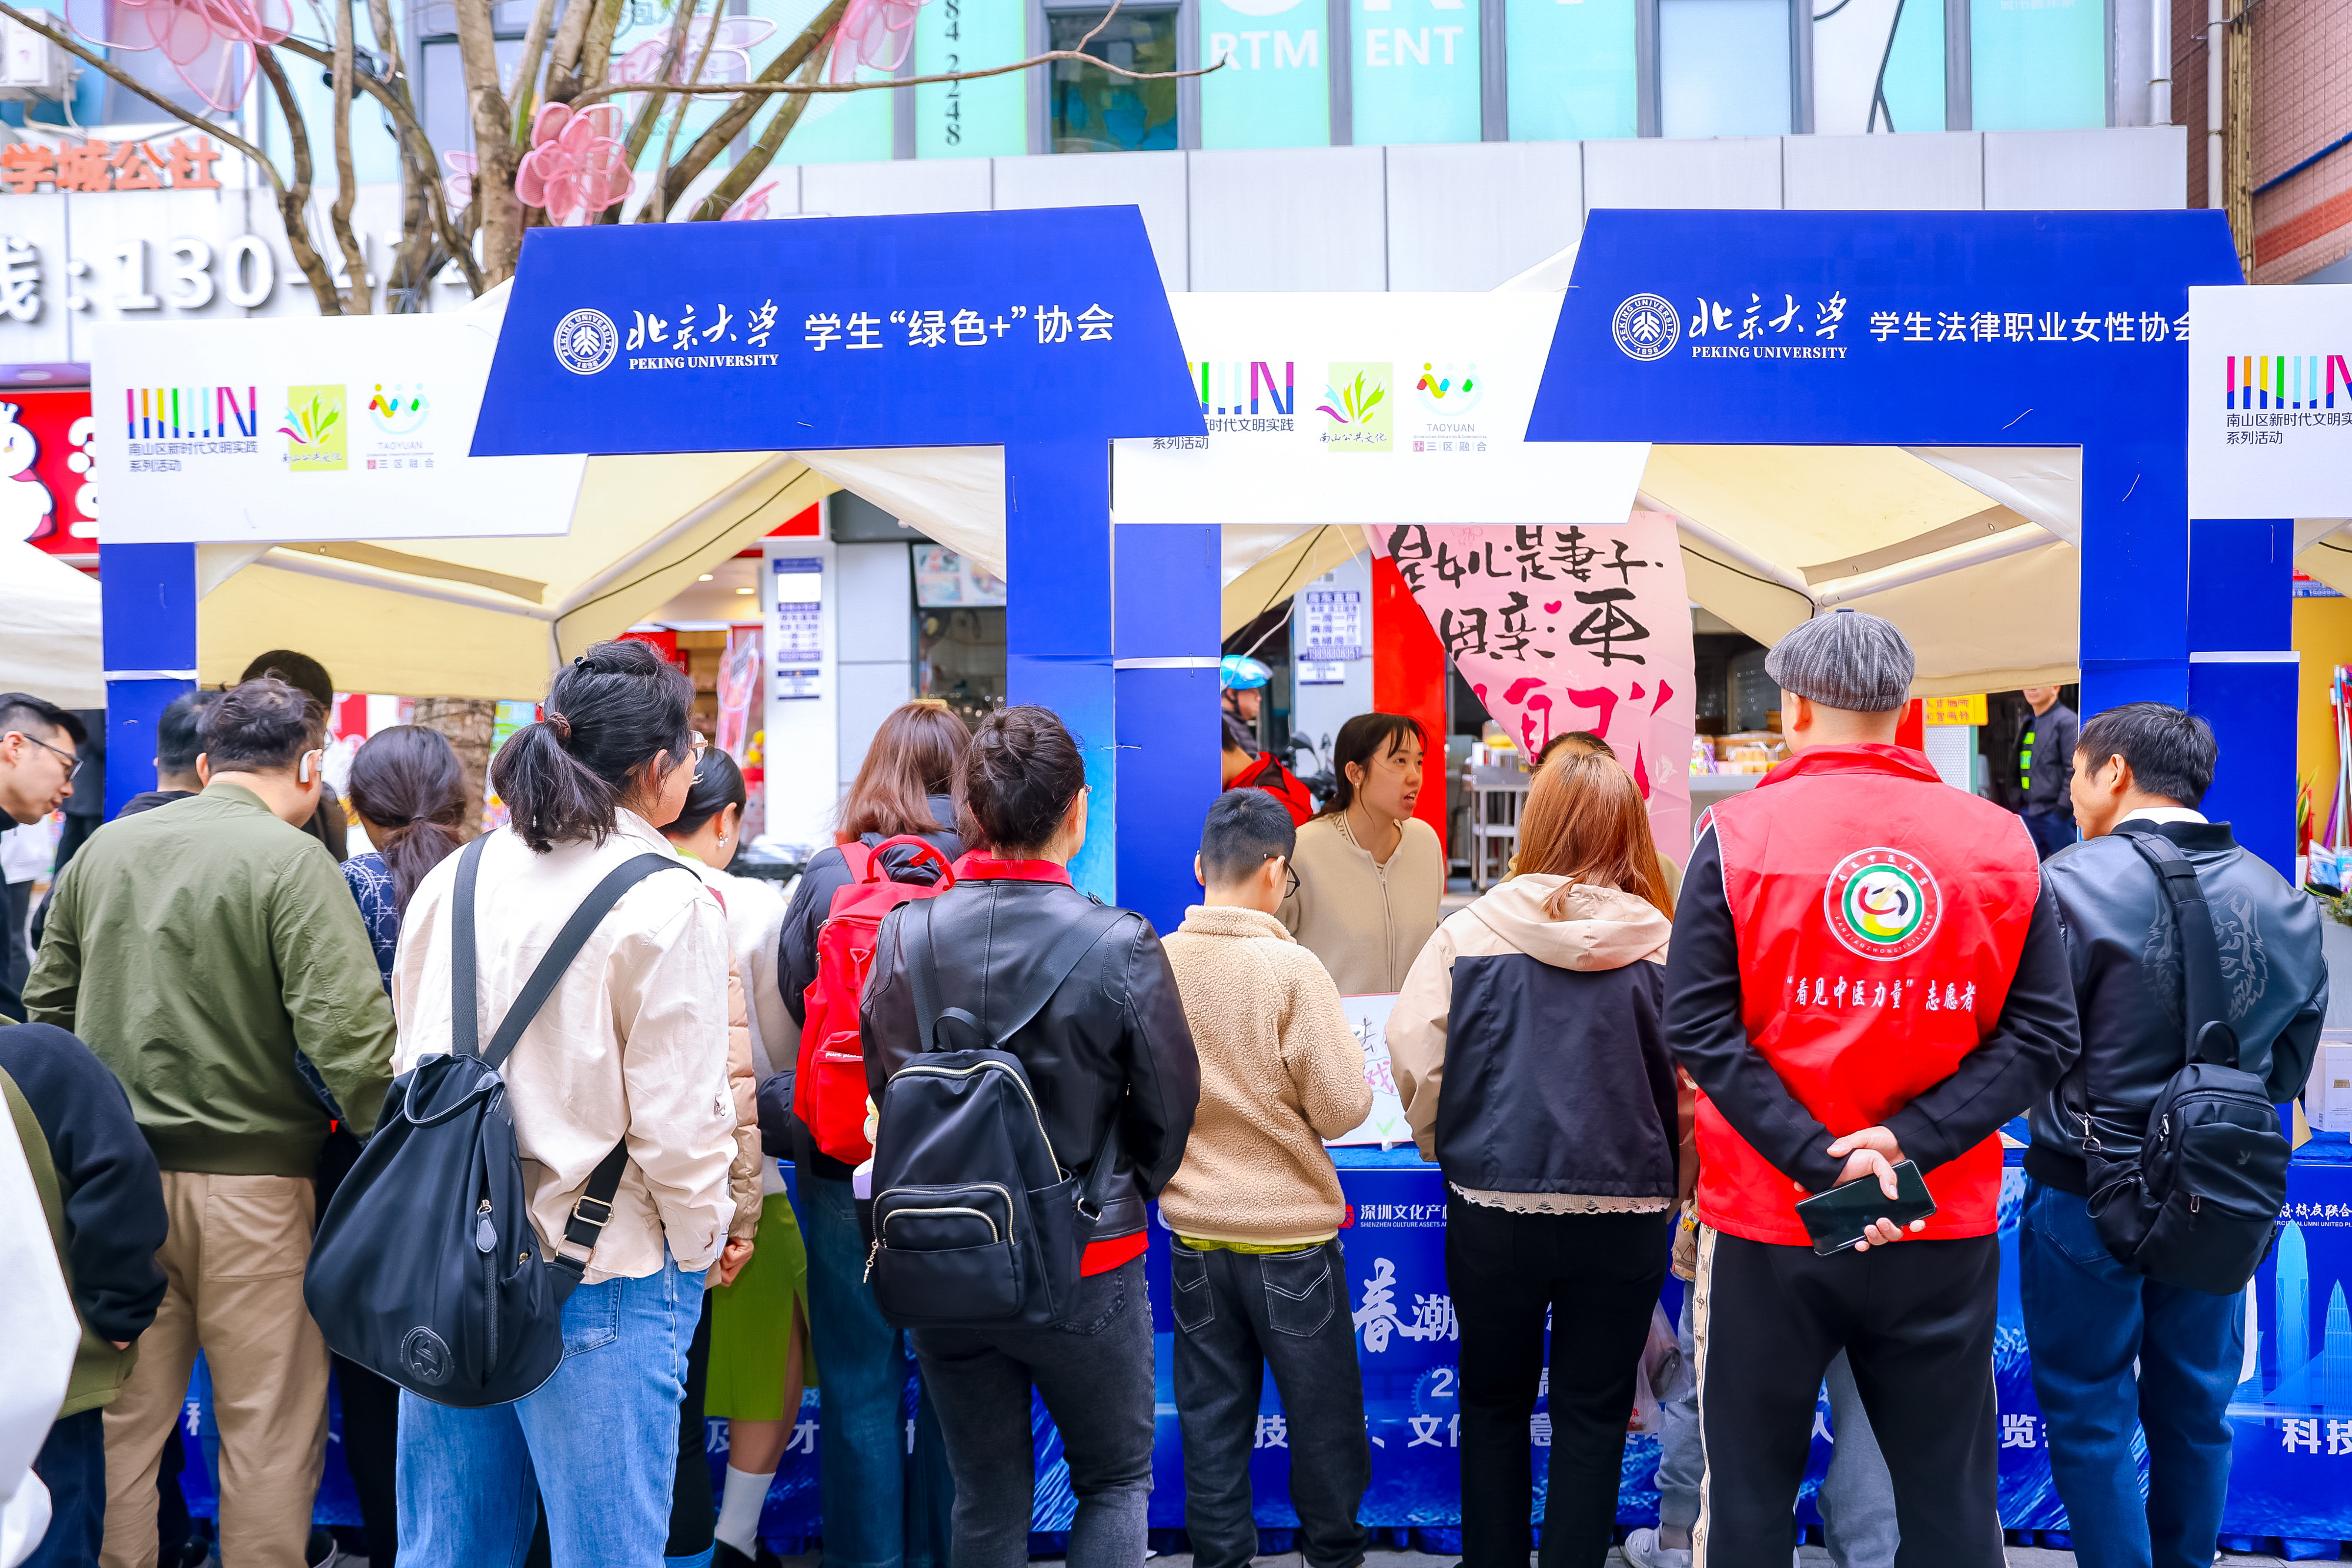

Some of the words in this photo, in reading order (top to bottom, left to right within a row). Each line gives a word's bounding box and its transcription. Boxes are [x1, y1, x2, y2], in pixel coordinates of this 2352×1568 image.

[1210, 29, 1318, 70] RTM
[1366, 26, 1464, 67] ENT
[1689, 290, 1847, 340] 北京大学
[626, 298, 779, 351] 北京大学
[1692, 346, 1750, 358] PEKING
[1753, 347, 1847, 359] UNIVERSITY
[629, 356, 685, 370] PEKING
[687, 354, 780, 368] UNIVERSITY
[1426, 424, 1475, 432] TAOYUAN
[1152, 436, 1209, 450] 系列活动
[2226, 430, 2283, 445] 系列活动
[1926, 979, 1976, 1012] 志愿者
